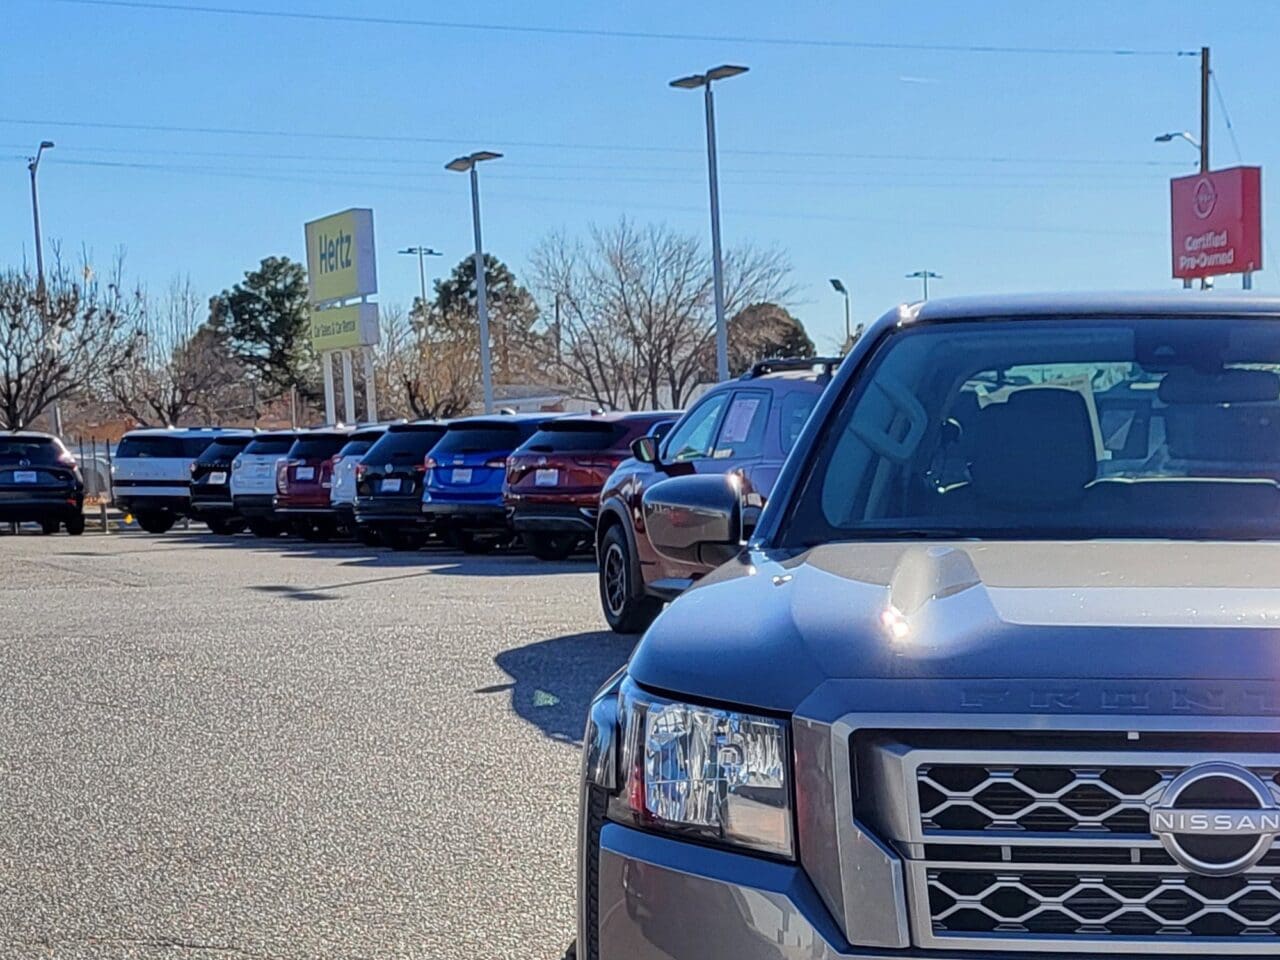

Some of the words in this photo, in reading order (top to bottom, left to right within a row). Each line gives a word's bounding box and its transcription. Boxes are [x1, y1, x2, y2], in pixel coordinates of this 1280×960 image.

[1185, 229, 1228, 252] Certified
[318, 230, 352, 275] Hertz
[1179, 247, 1235, 270] Pre-Owned
[1154, 811, 1280, 831] NISSAN
